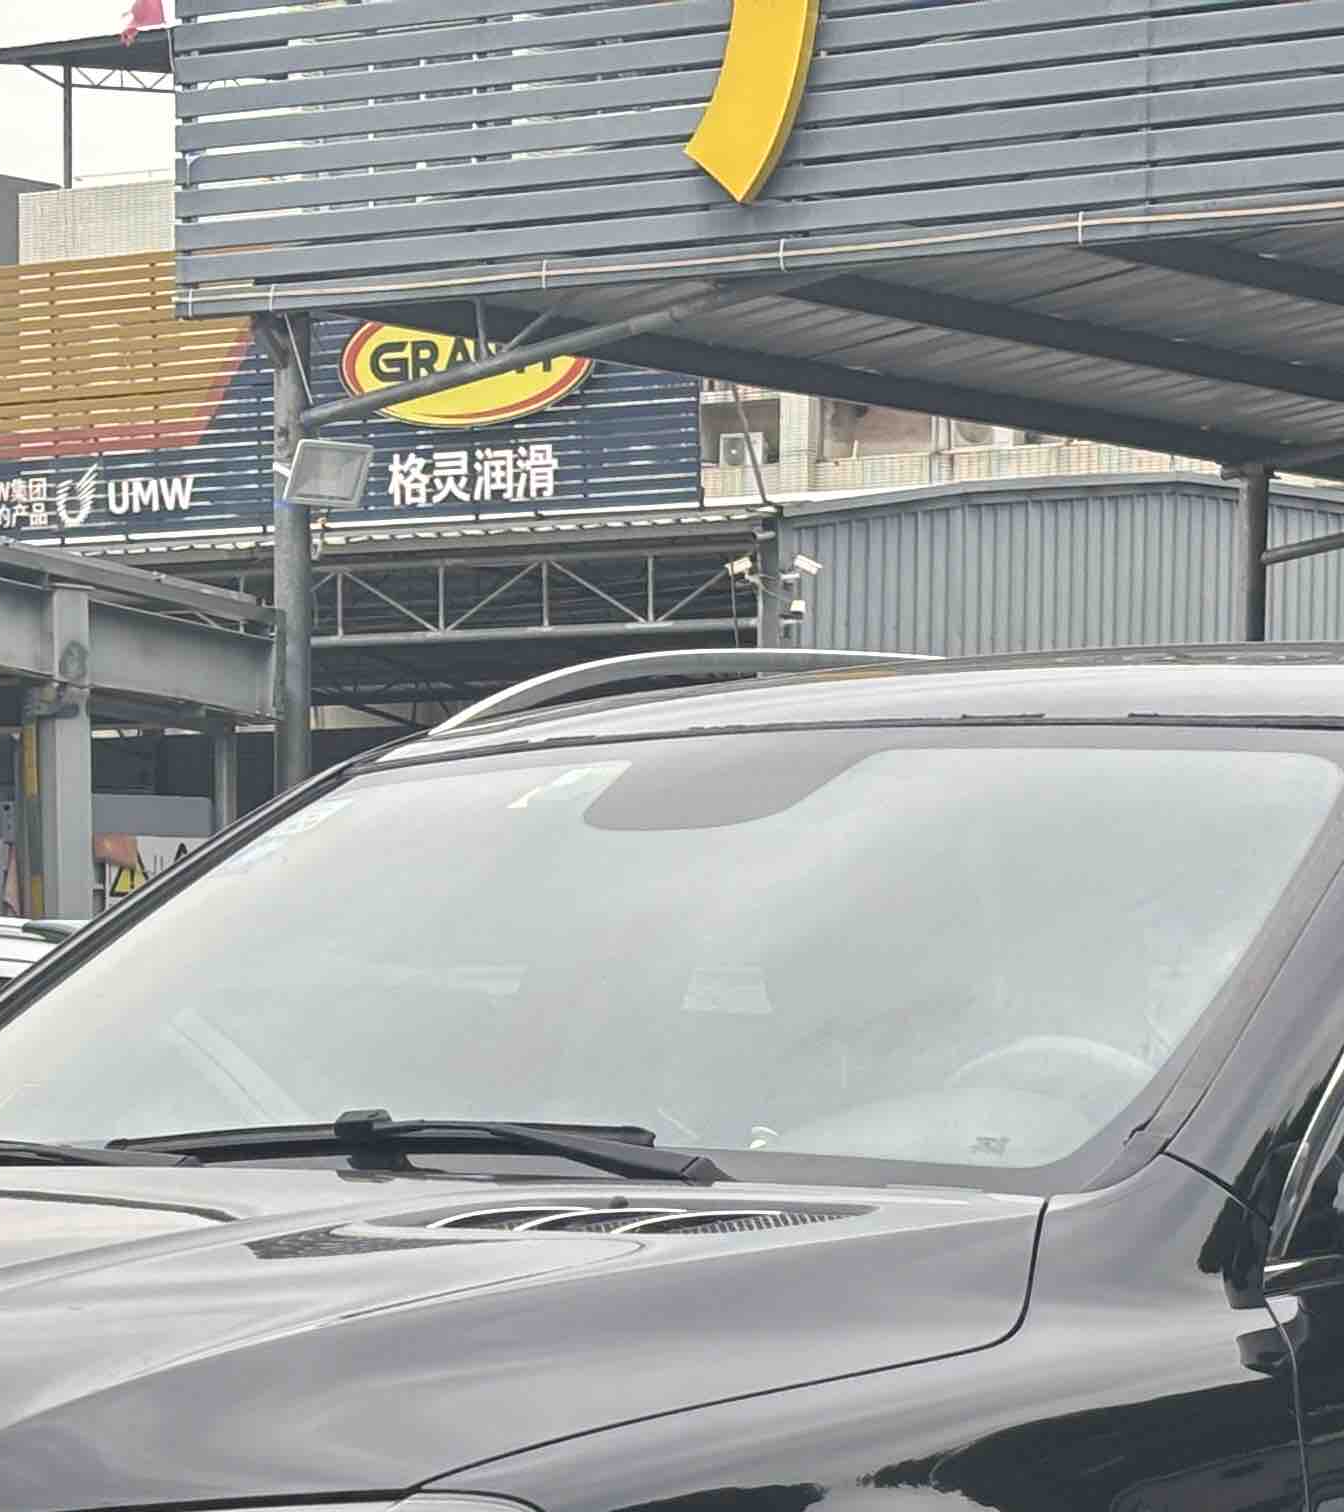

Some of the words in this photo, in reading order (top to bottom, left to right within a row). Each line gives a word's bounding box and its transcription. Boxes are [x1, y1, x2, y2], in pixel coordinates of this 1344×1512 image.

[107, 476, 195, 514] UMW
[387, 443, 559, 507] 格灵润滑
